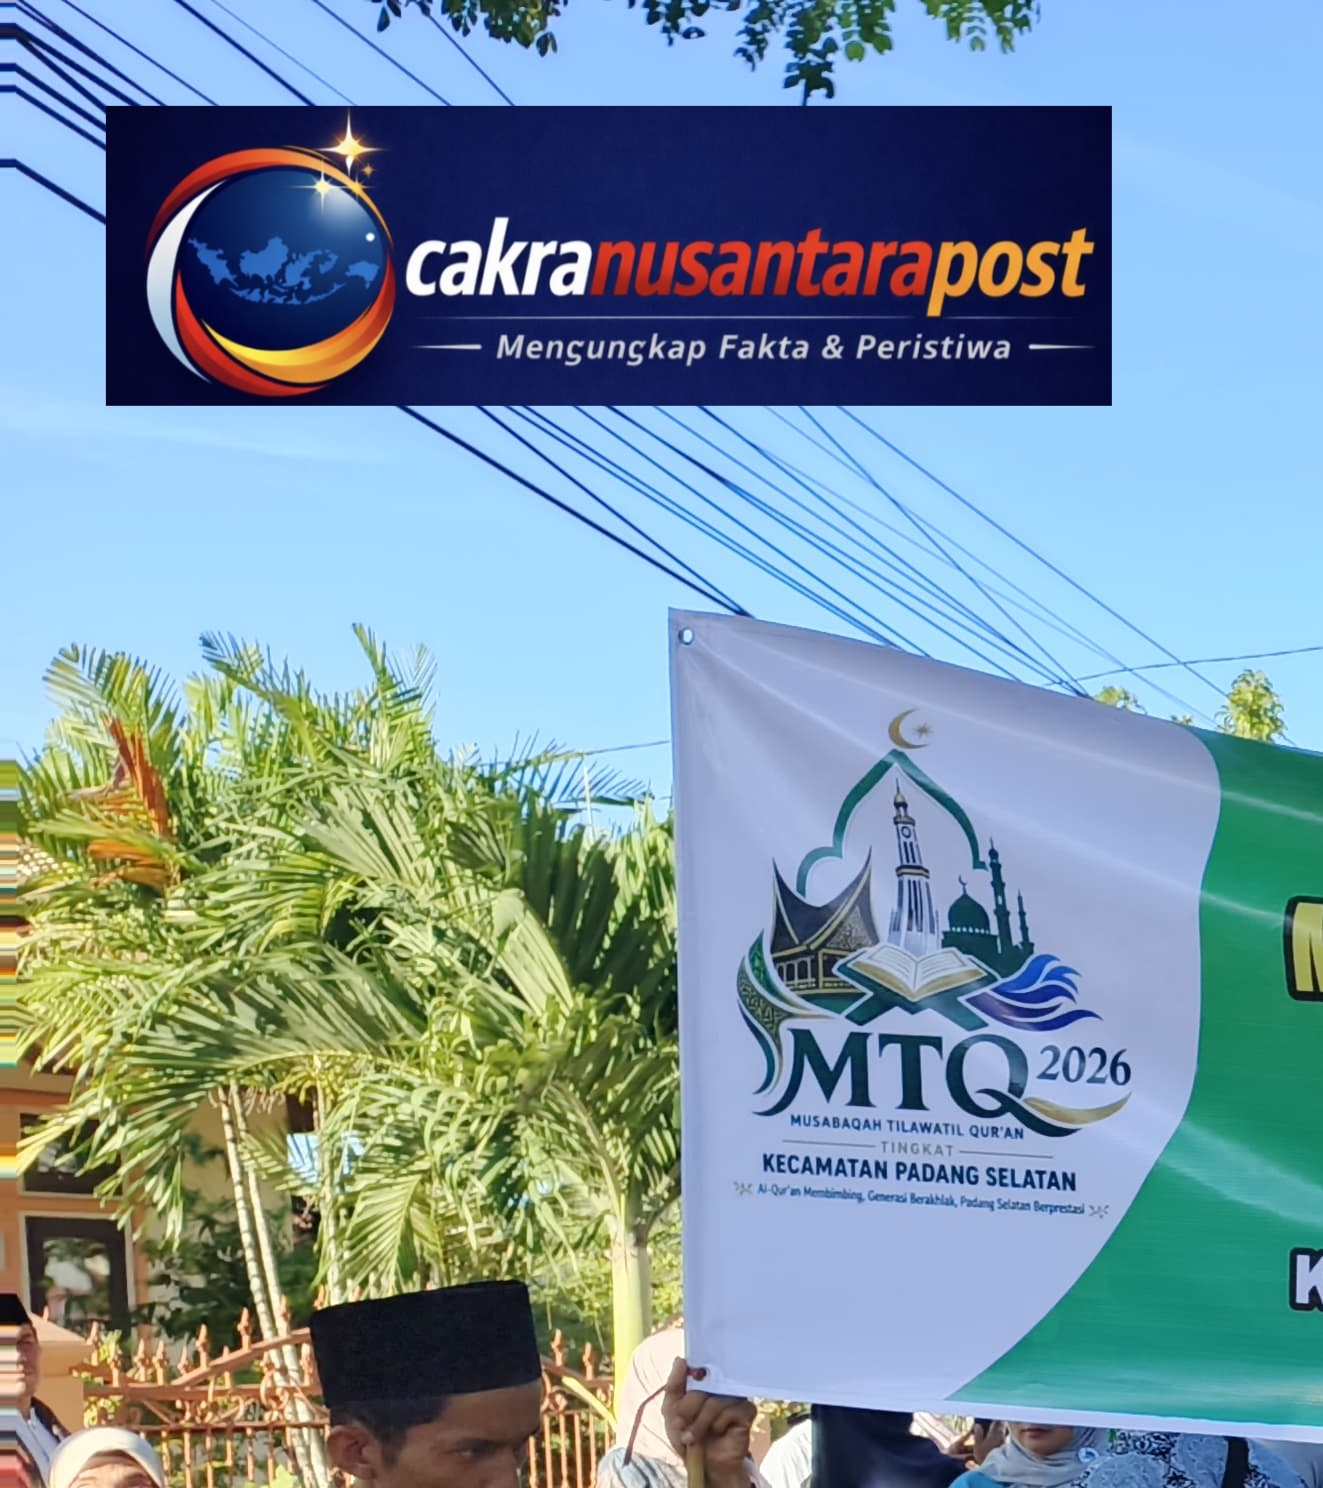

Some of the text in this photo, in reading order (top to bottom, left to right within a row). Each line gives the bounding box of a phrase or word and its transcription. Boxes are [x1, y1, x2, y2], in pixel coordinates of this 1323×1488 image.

[753, 1028, 1132, 1137] MTQ 2026
[790, 1114, 1025, 1140] MUSABAQAH TILAWATIL QUR'AN
[880, 1141, 955, 1157] TINGKAT
[762, 1153, 1077, 1192] KECAMATAN PADANG SELATAN
[867, 1190, 908, 1204] Generasi
[960, 1195, 995, 1211] Padang
[996, 1198, 1031, 1212] Selatan
[1033, 1201, 1086, 1217] Berprestasi
